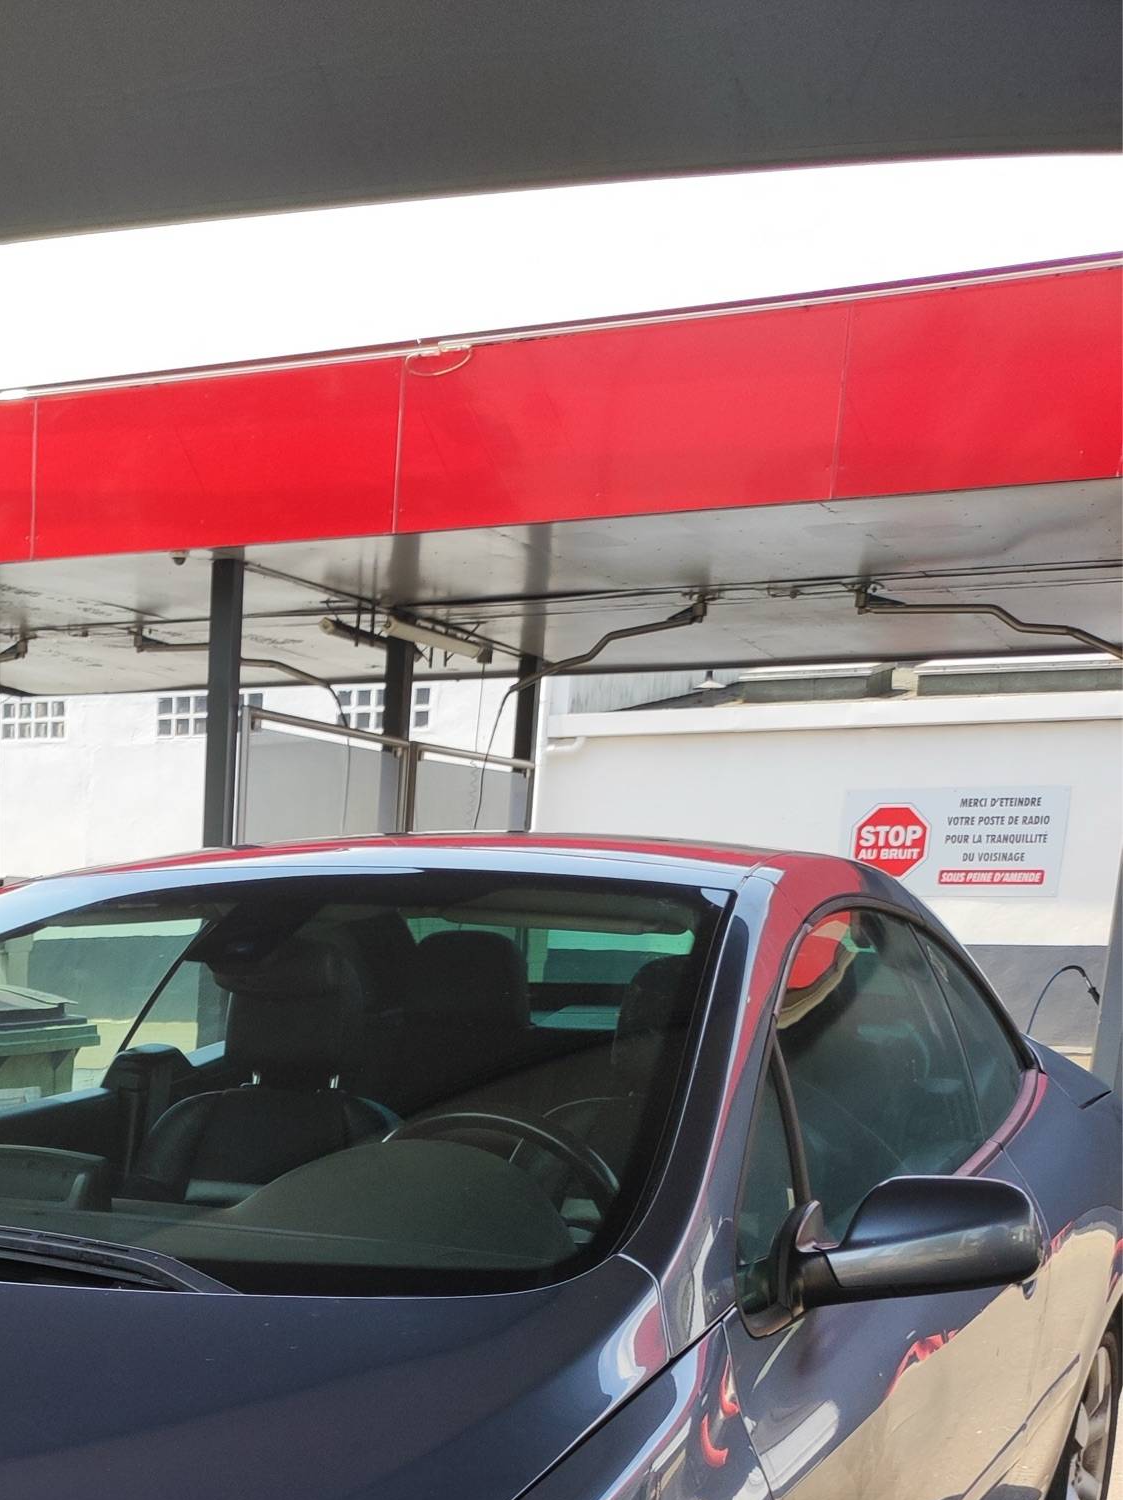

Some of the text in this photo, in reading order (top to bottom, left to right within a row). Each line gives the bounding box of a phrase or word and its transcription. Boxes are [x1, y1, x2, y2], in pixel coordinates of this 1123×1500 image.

[959, 797, 988, 808] MERCI
[947, 815, 1051, 826] VOTRE POSTE DE RADIO
[859, 824, 923, 847] STOP
[944, 834, 970, 844] POUR
[972, 834, 983, 844] LA
[857, 848, 921, 860] AU BRUIT
[962, 852, 1026, 862] DU VOISINAGE
[940, 871, 1042, 883] SOUS PEINE D'AMENDE
